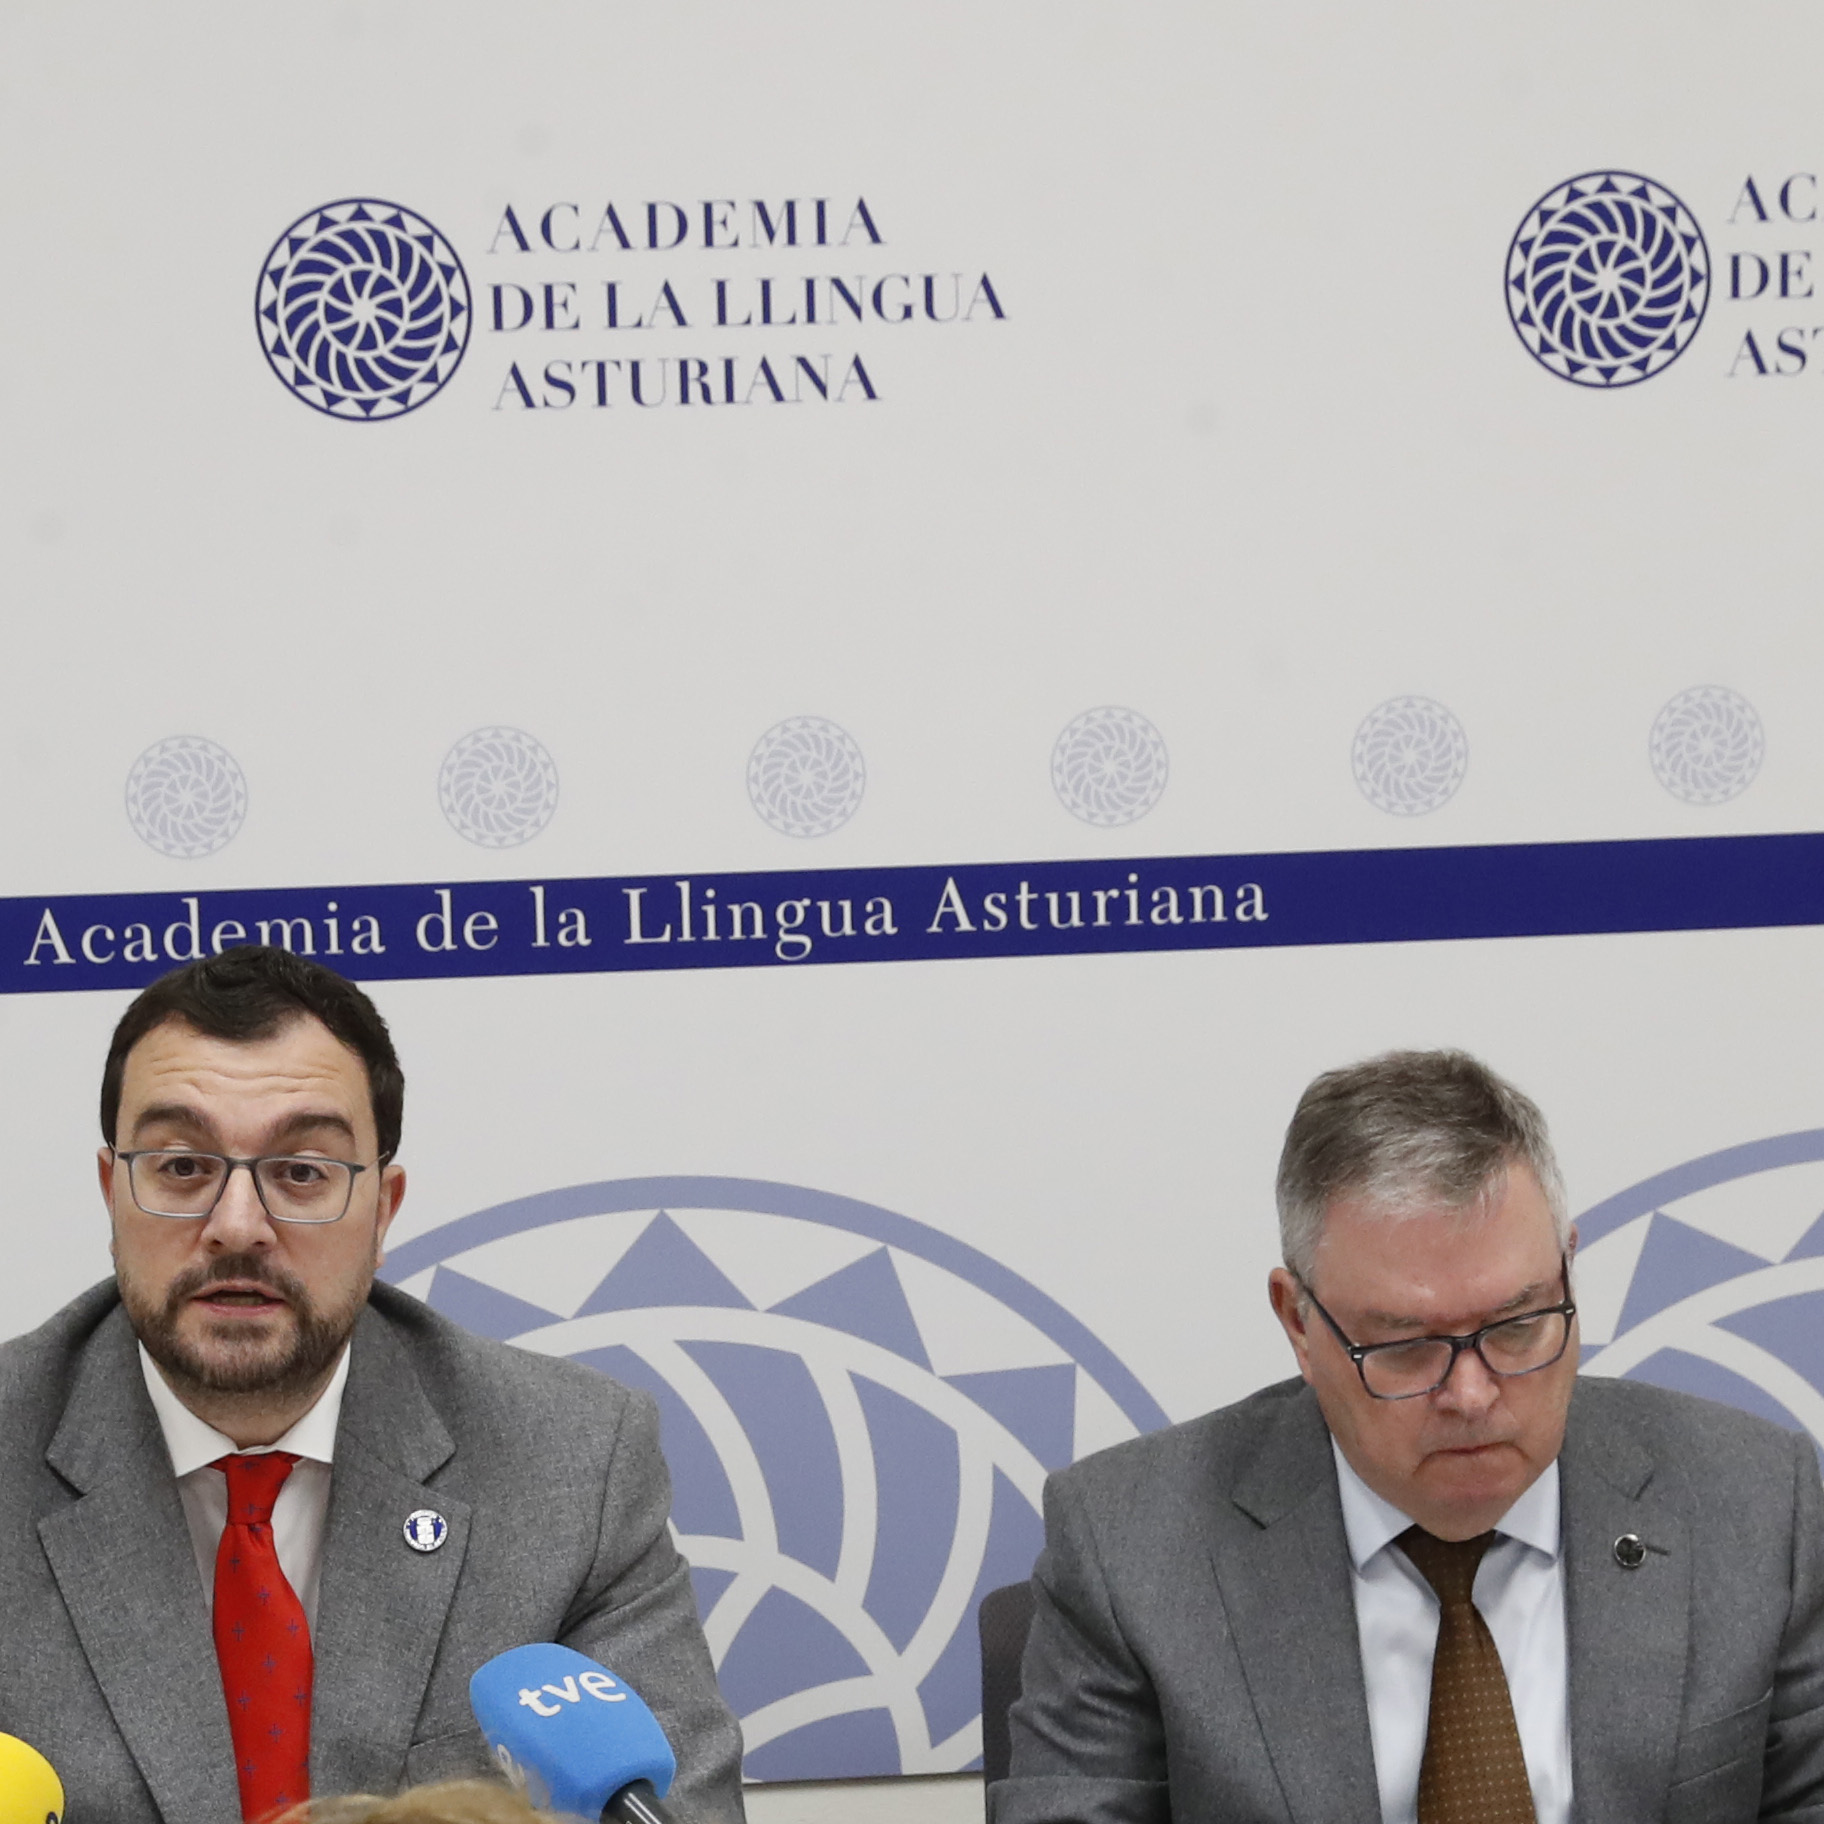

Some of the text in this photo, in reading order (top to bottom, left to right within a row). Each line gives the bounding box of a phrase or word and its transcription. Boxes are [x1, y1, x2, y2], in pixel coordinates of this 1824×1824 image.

[486, 196, 887, 256] ACADEMIA
[488, 271, 1010, 332] DE LA LLINGUA
[1727, 251, 1814, 300] DE
[492, 352, 882, 411] ASTURIANA
[23, 873, 1269, 965] Academia de la Llingua Asturiana
[518, 1671, 626, 1717] tve
